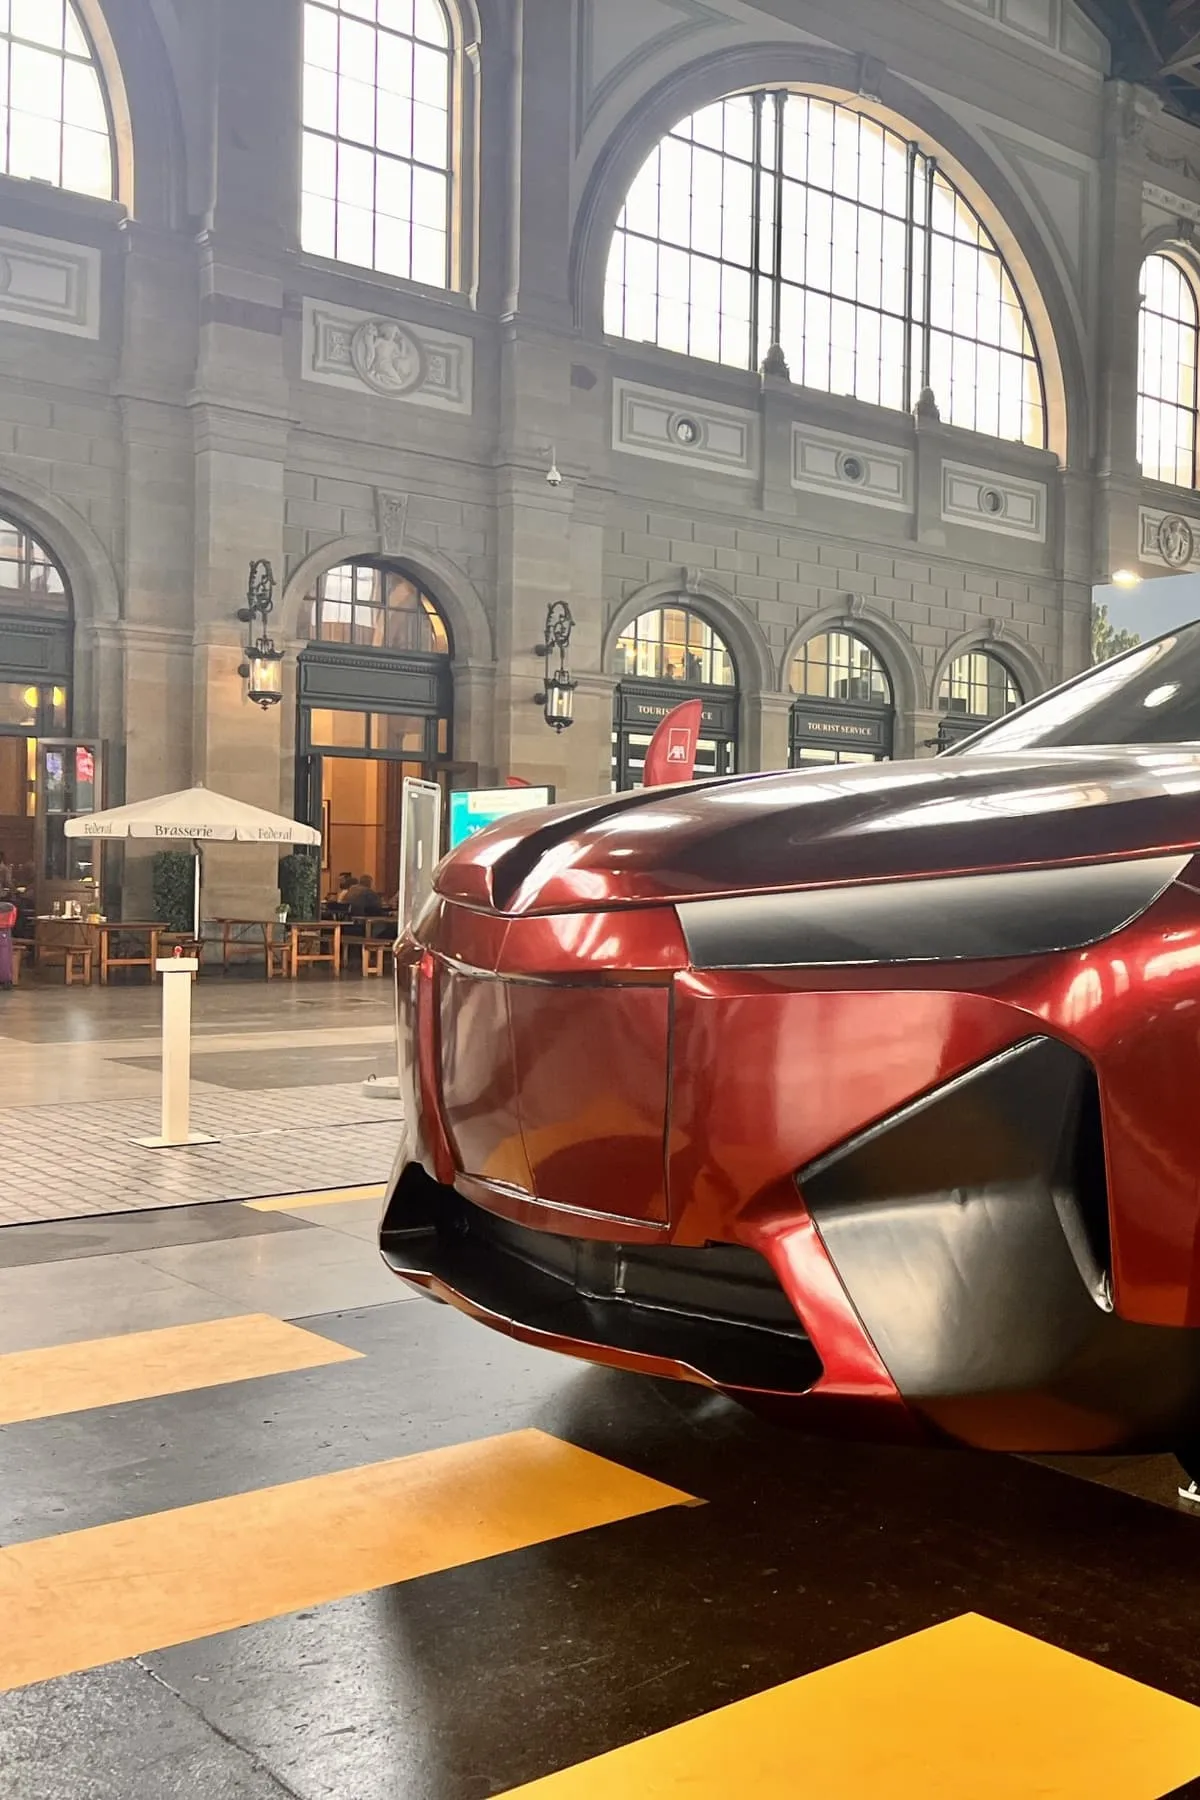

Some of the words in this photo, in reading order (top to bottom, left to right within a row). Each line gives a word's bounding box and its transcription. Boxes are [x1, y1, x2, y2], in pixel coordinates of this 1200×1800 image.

[638, 704, 672, 716] TOURIS
[808, 722, 840, 733] TOURIST
[841, 725, 872, 736] SERVICE
[84, 823, 113, 835] Federal
[155, 824, 213, 838] Brasserie
[258, 827, 293, 841] Federal
